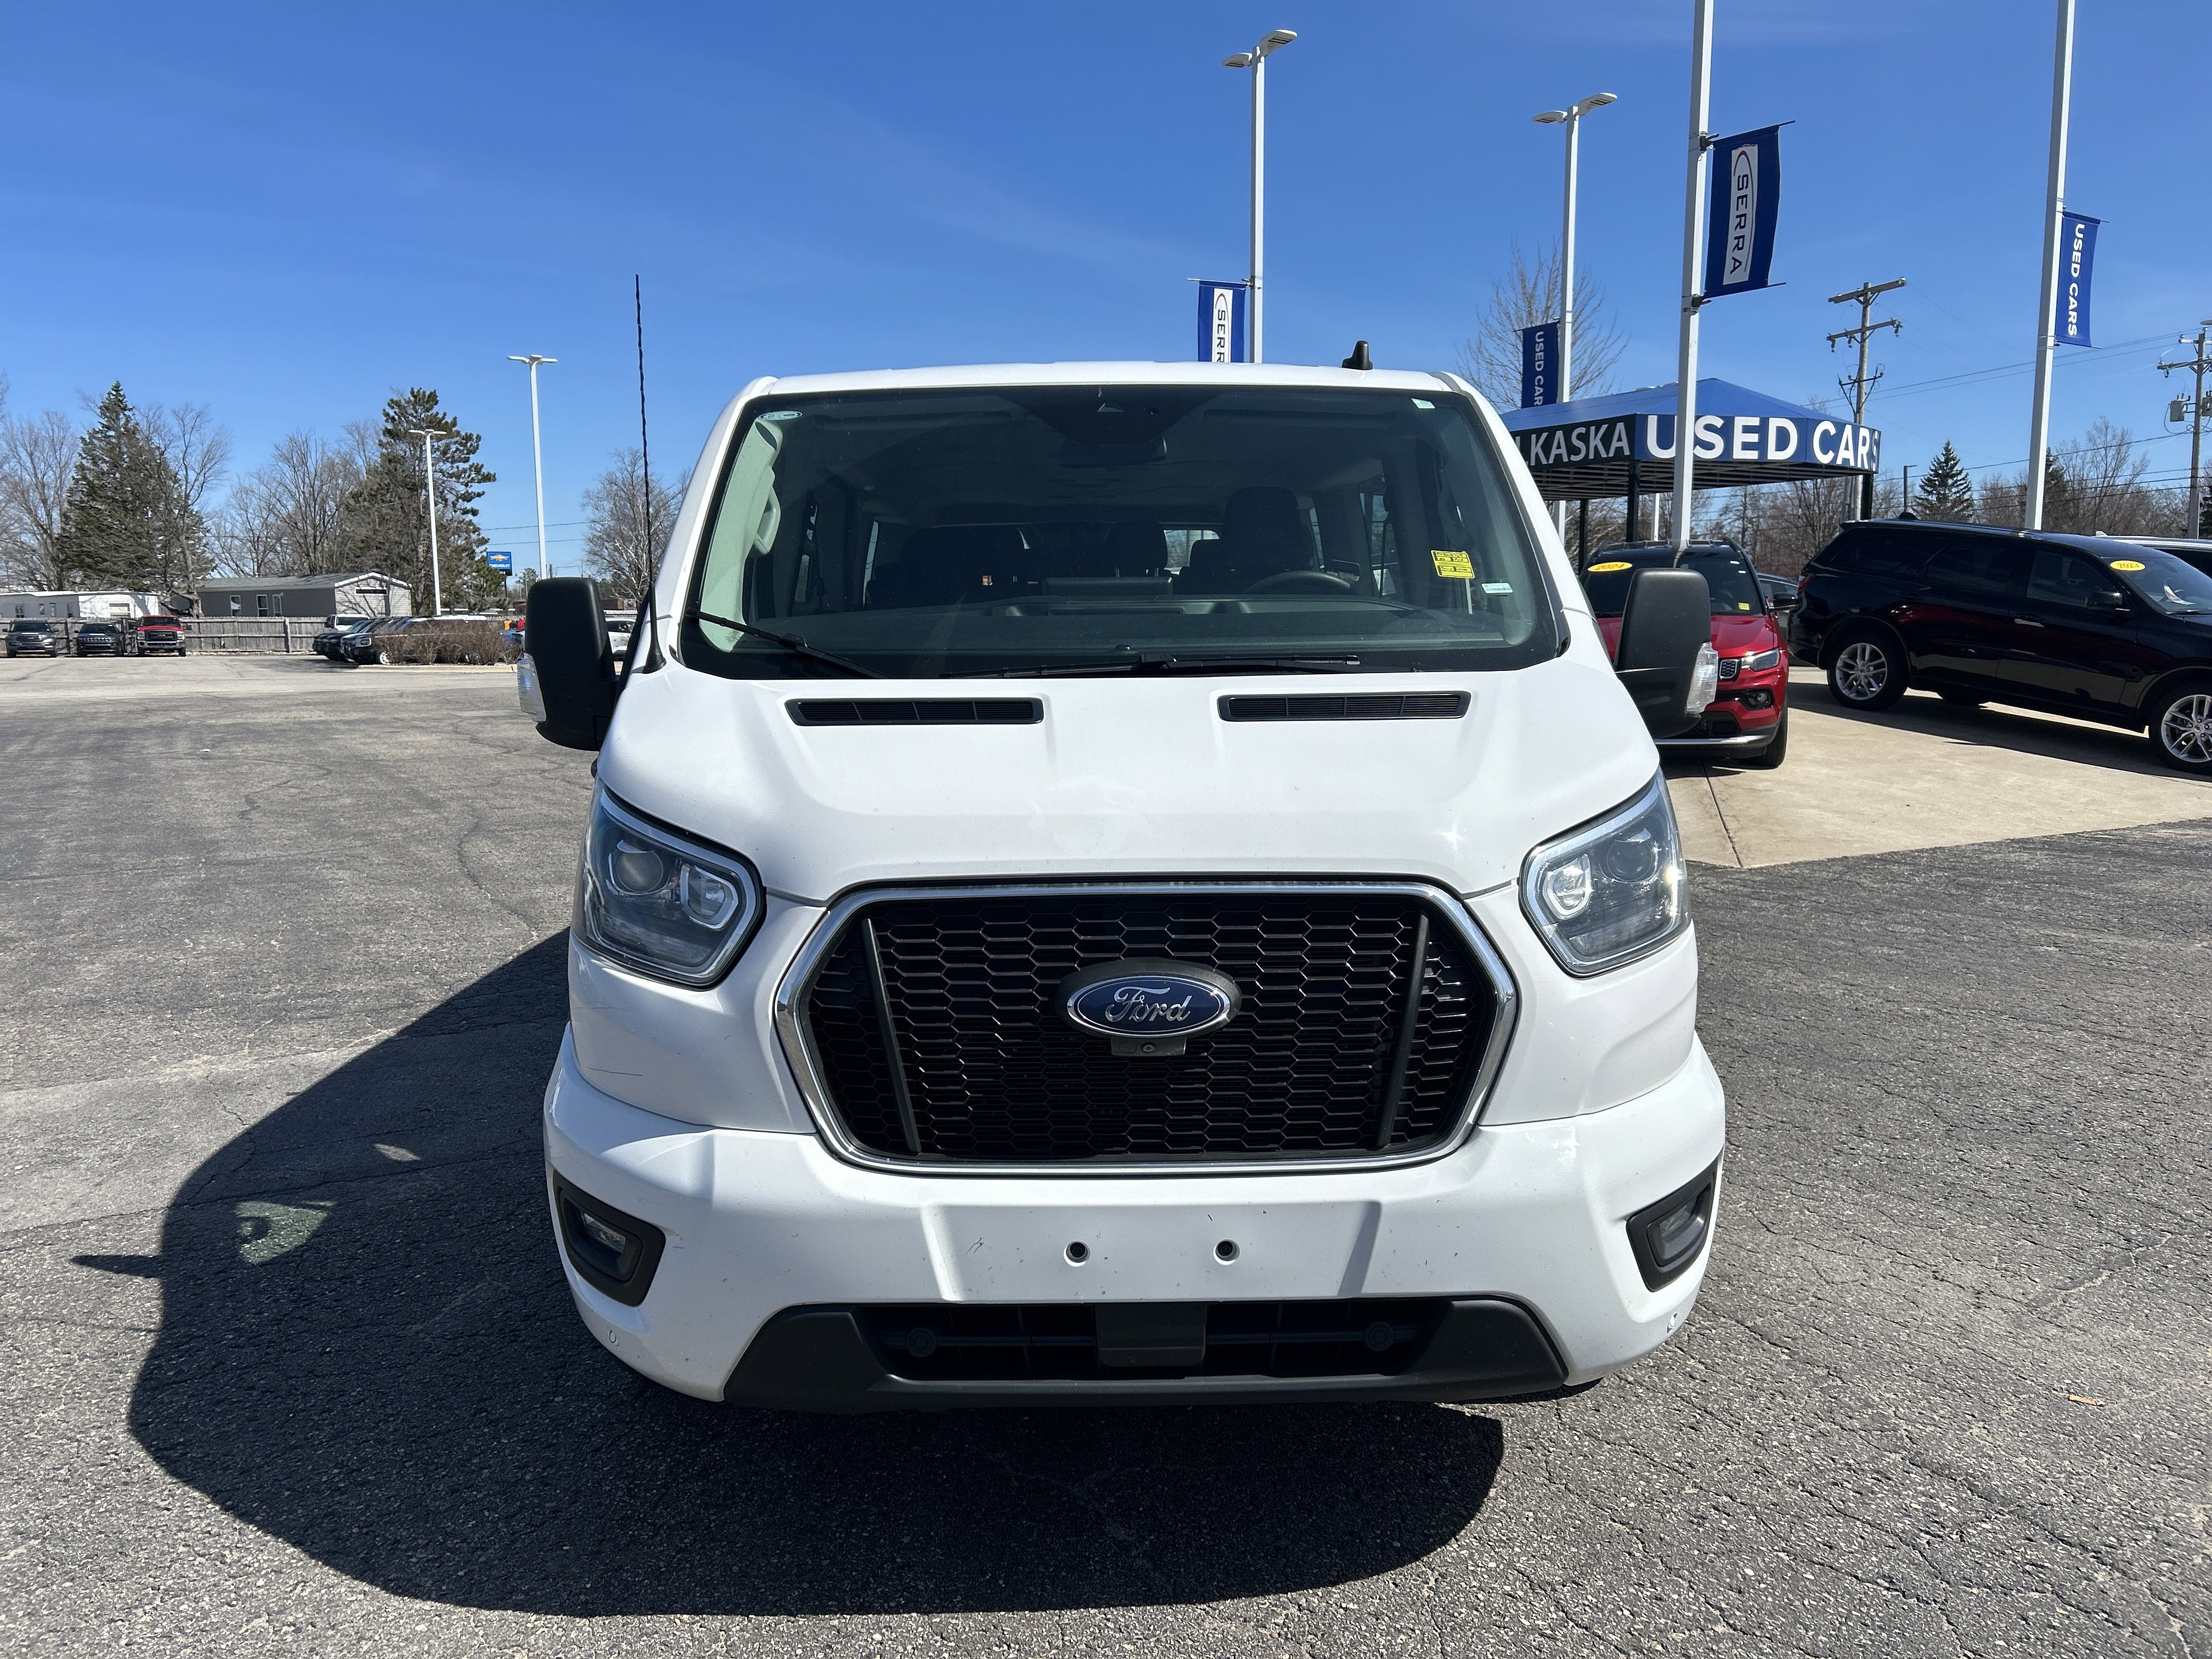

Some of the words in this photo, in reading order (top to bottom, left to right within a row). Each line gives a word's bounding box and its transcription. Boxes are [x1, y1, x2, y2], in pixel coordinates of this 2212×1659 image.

[1730, 174, 1749, 275] SERRA
[2071, 223, 2085, 278] USED
[2068, 283, 2078, 336] CARS
[1534, 331, 1544, 371] USED
[1646, 415, 1798, 460] USED
[1813, 420, 1879, 472] CARS
[1105, 986, 1193, 1022] Ford
